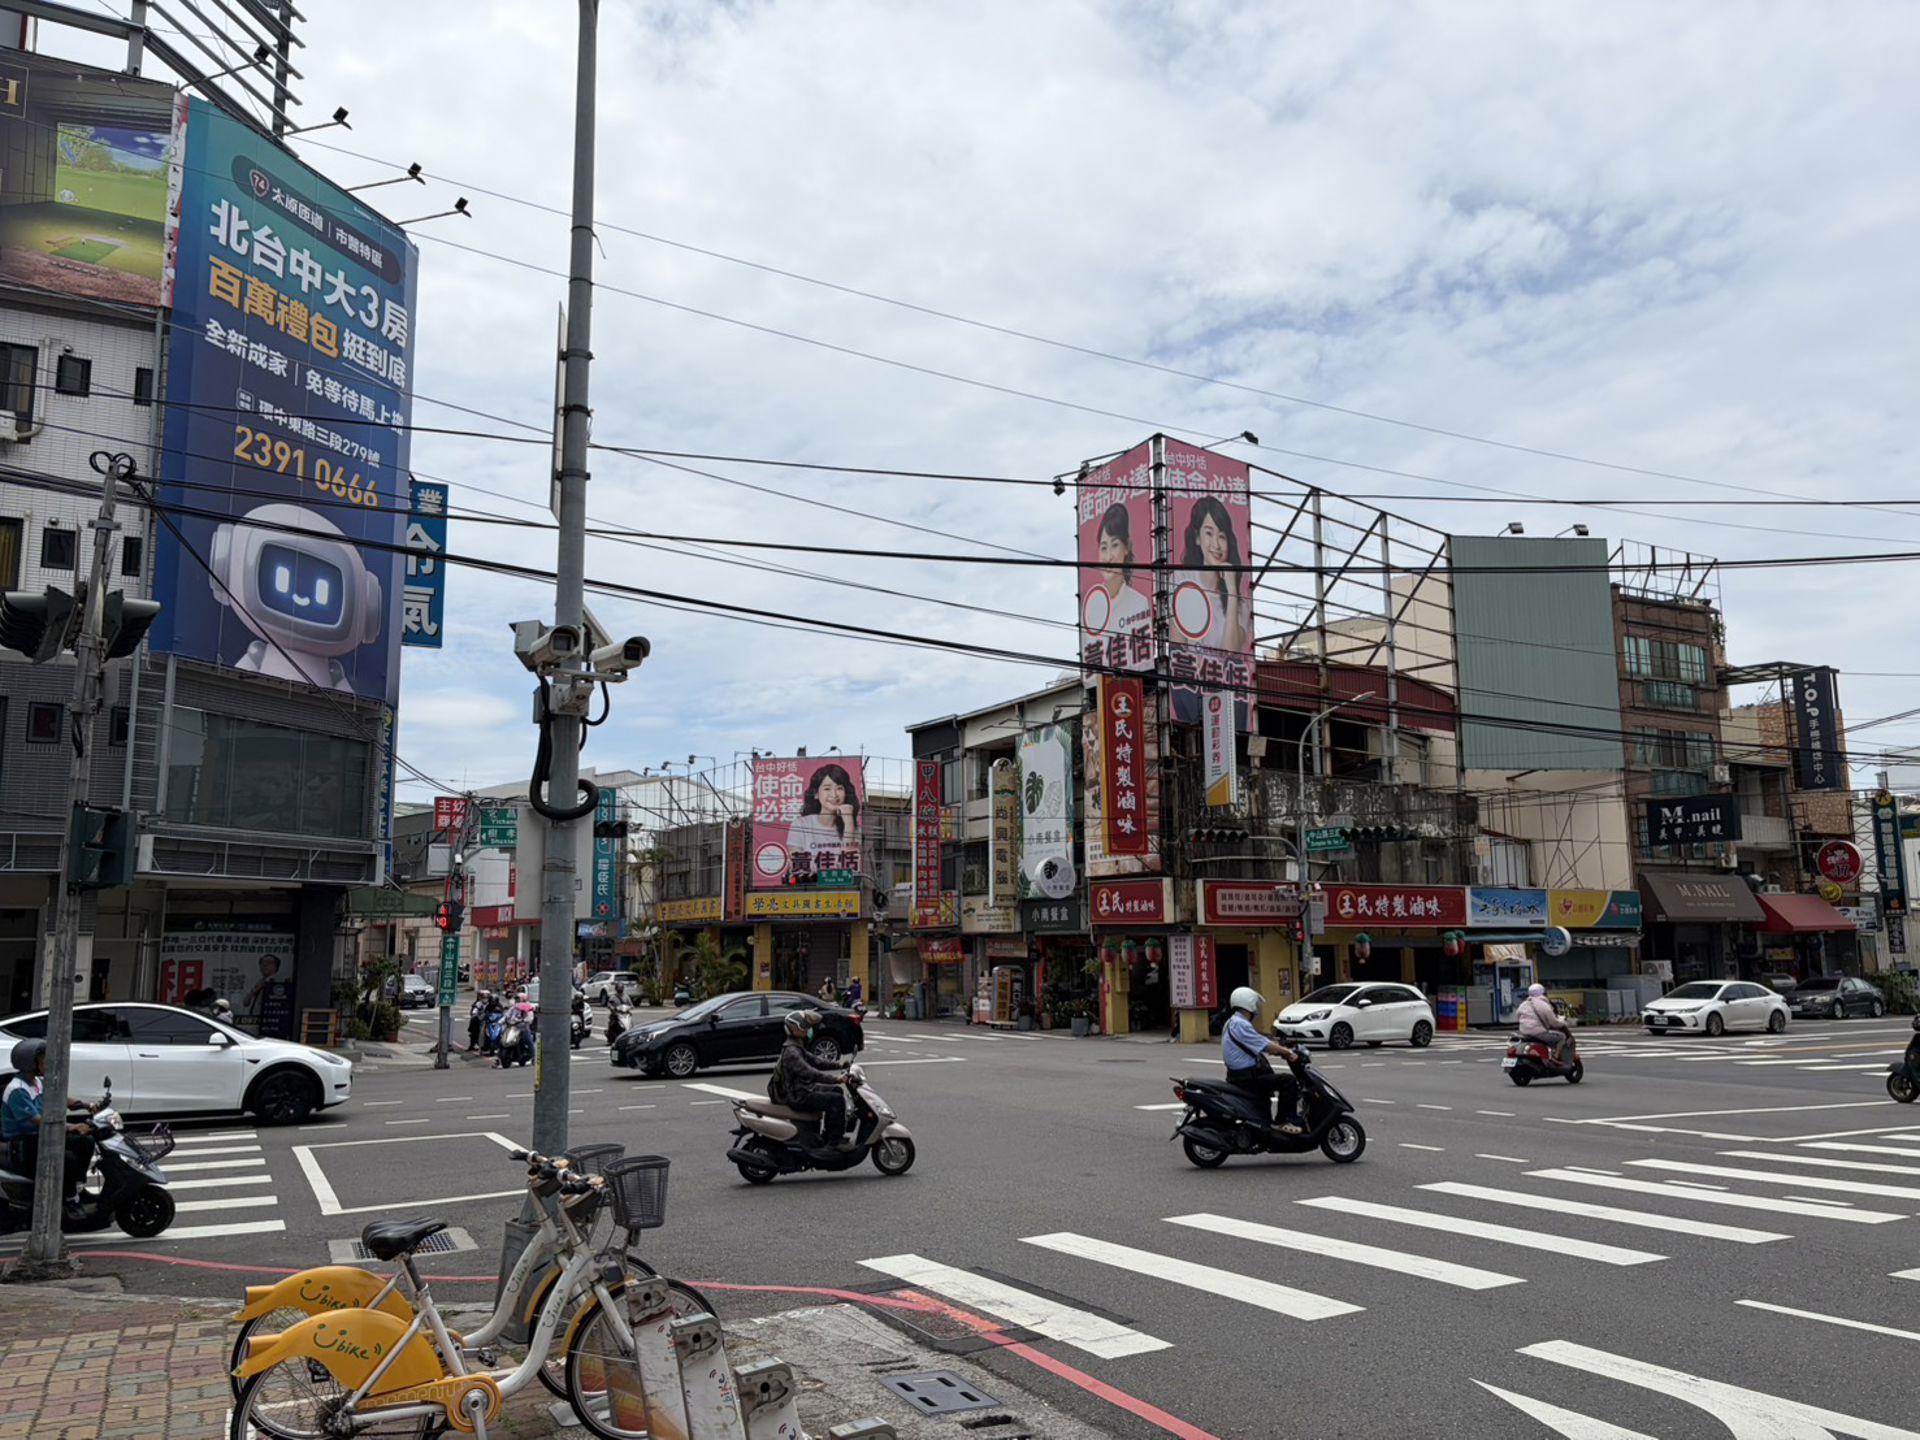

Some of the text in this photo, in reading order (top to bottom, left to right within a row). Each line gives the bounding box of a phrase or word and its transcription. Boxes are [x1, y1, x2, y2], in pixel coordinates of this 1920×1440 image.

[253, 174, 266, 190] 74
[209, 199, 408, 348] 北台中大3房
[208, 256, 406, 389] 百萬禮包 挺到底
[204, 318, 288, 378] 全新成家
[258, 400, 381, 468] 環中東路三段279號
[234, 425, 379, 507] 2391 0666
[1080, 464, 1149, 523] 使命必達
[1166, 468, 1249, 506] 使命必達
[1803, 673, 1819, 717] T.O.P
[755, 761, 798, 773] 台中好恬
[755, 773, 804, 799] 使命
[1113, 696, 1137, 835] 王氏特製滷味
[754, 798, 804, 822] 必達
[1660, 805, 1721, 825] M.nail
[791, 850, 860, 873] 黃佳恬
[1339, 893, 1442, 918] 王氏特製滷味
